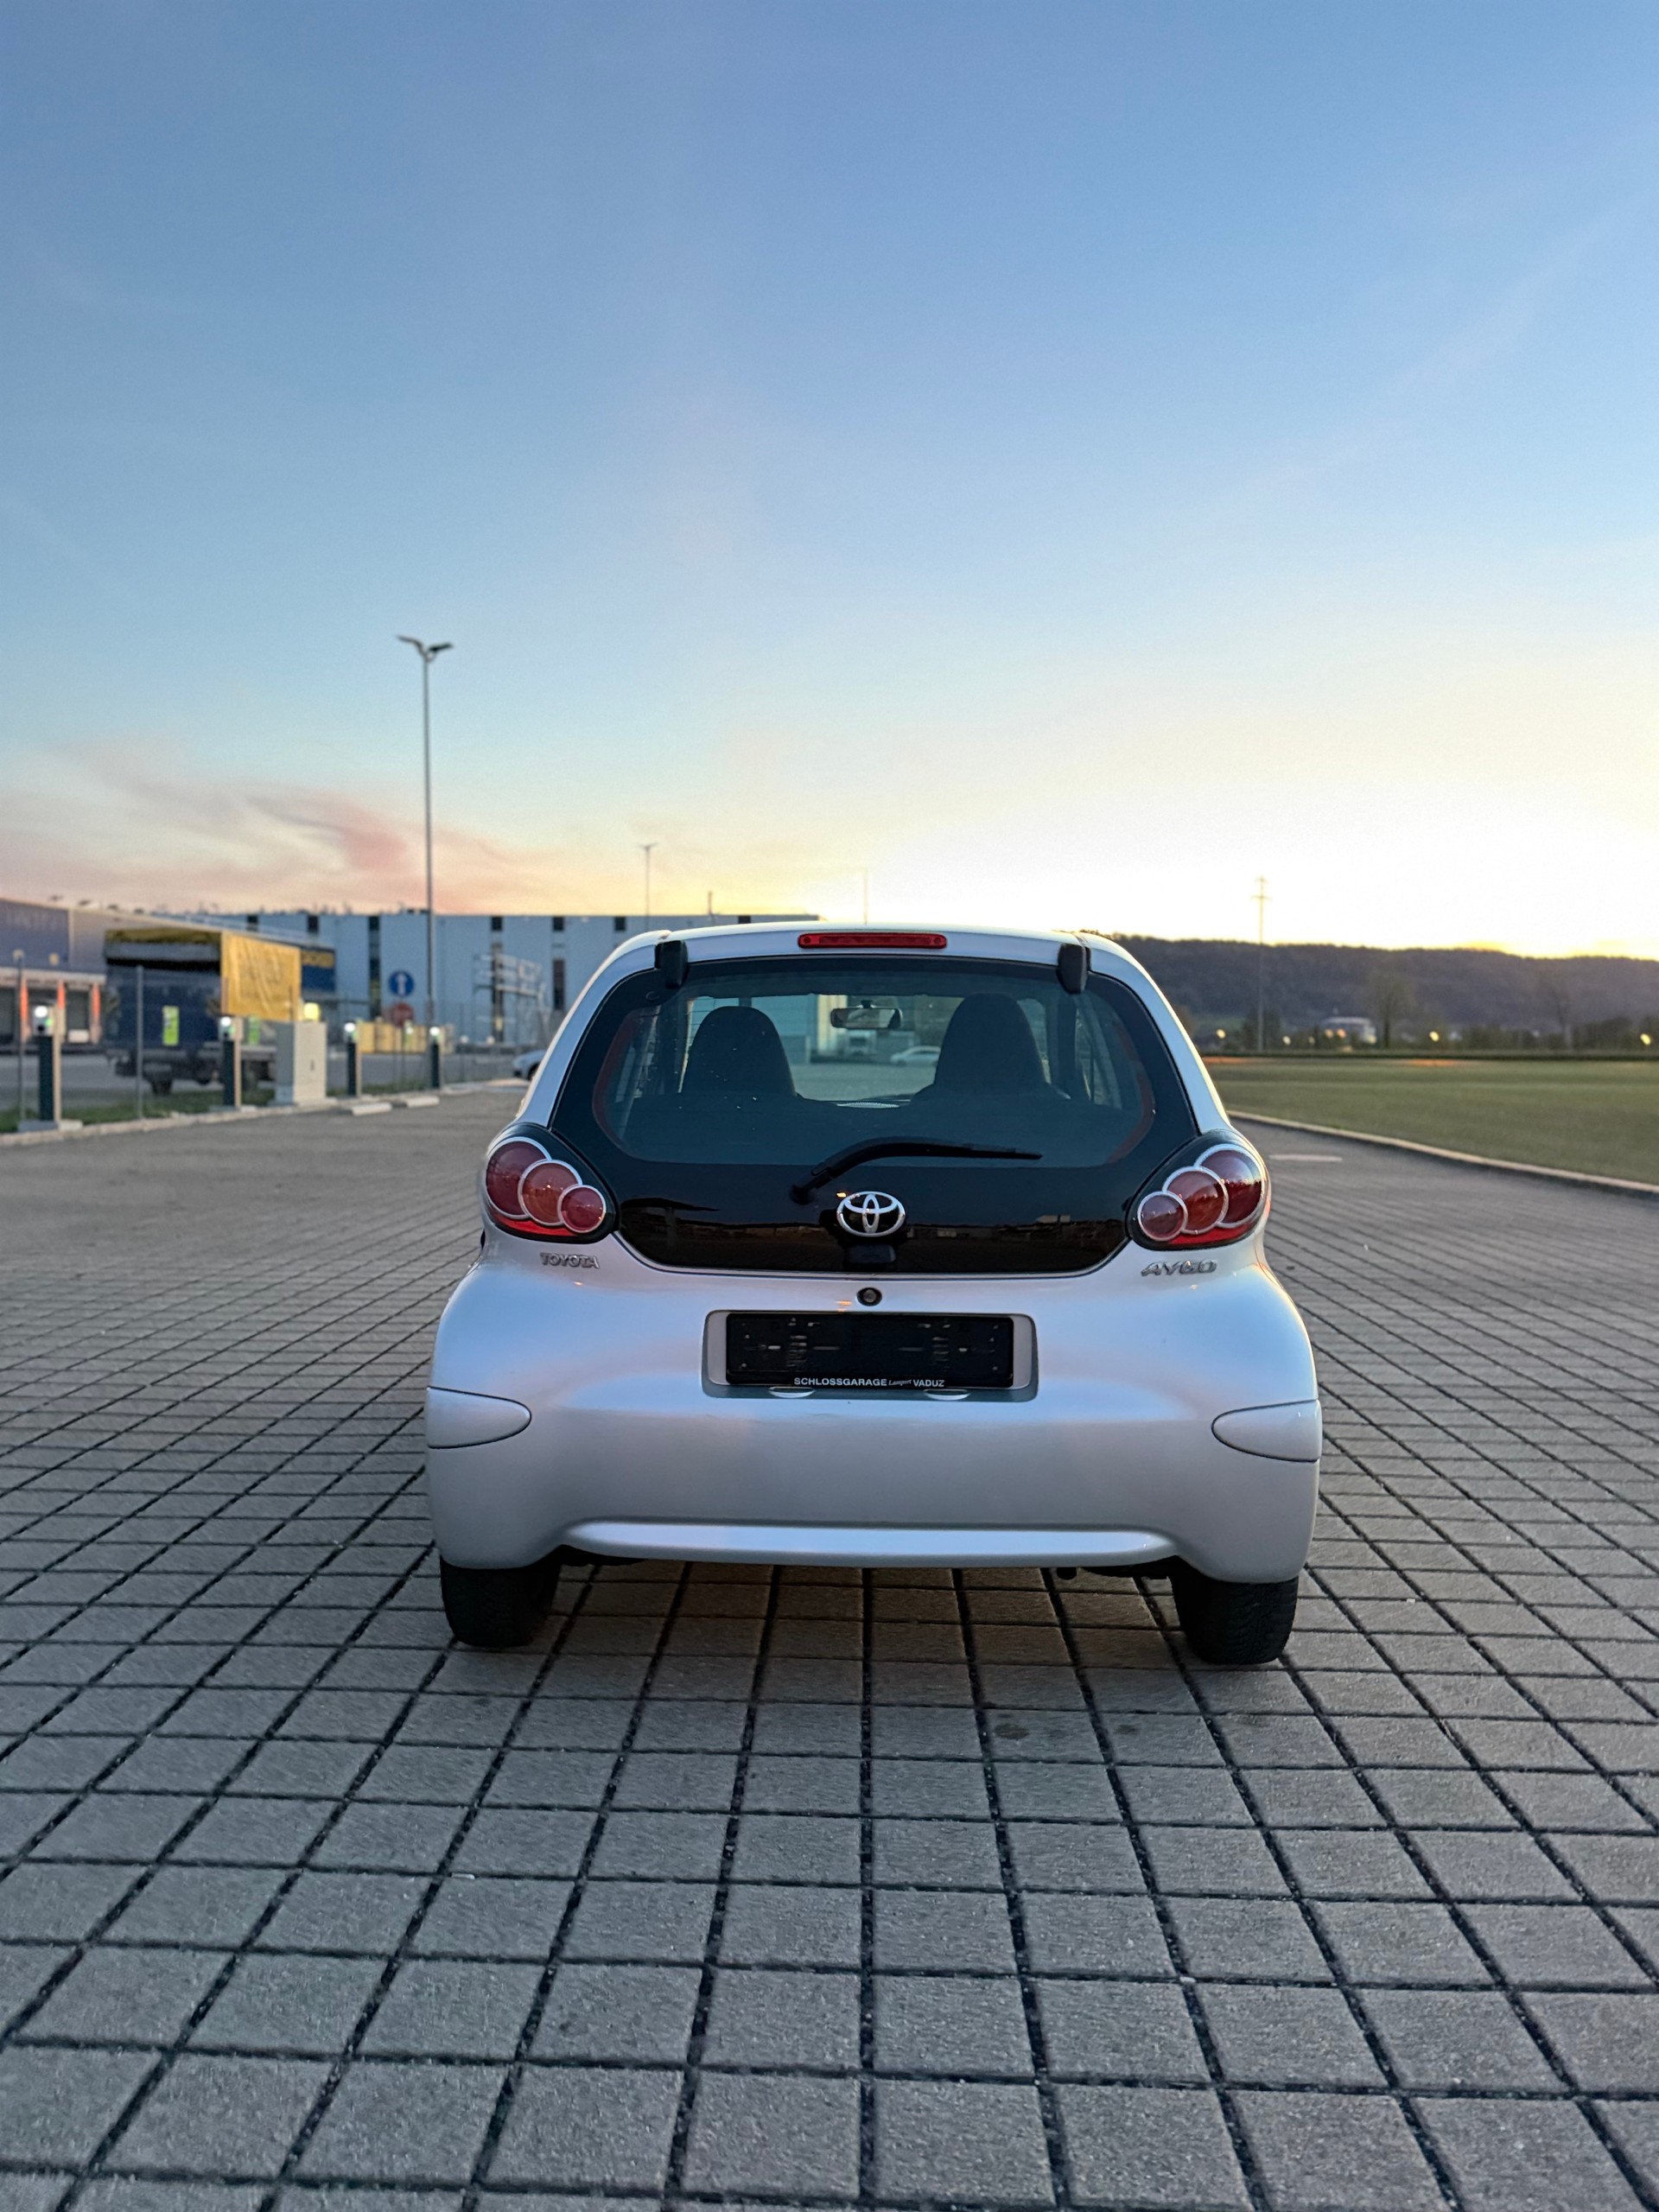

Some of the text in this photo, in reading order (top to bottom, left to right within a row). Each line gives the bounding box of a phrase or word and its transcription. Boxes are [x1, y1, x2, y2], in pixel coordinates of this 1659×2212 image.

[539, 1252, 600, 1269] TOYOTA
[1141, 1259, 1217, 1277] AYGO
[793, 1376, 887, 1387] SCHLOSSGARAGE
[912, 1378, 945, 1388] VADUZ
